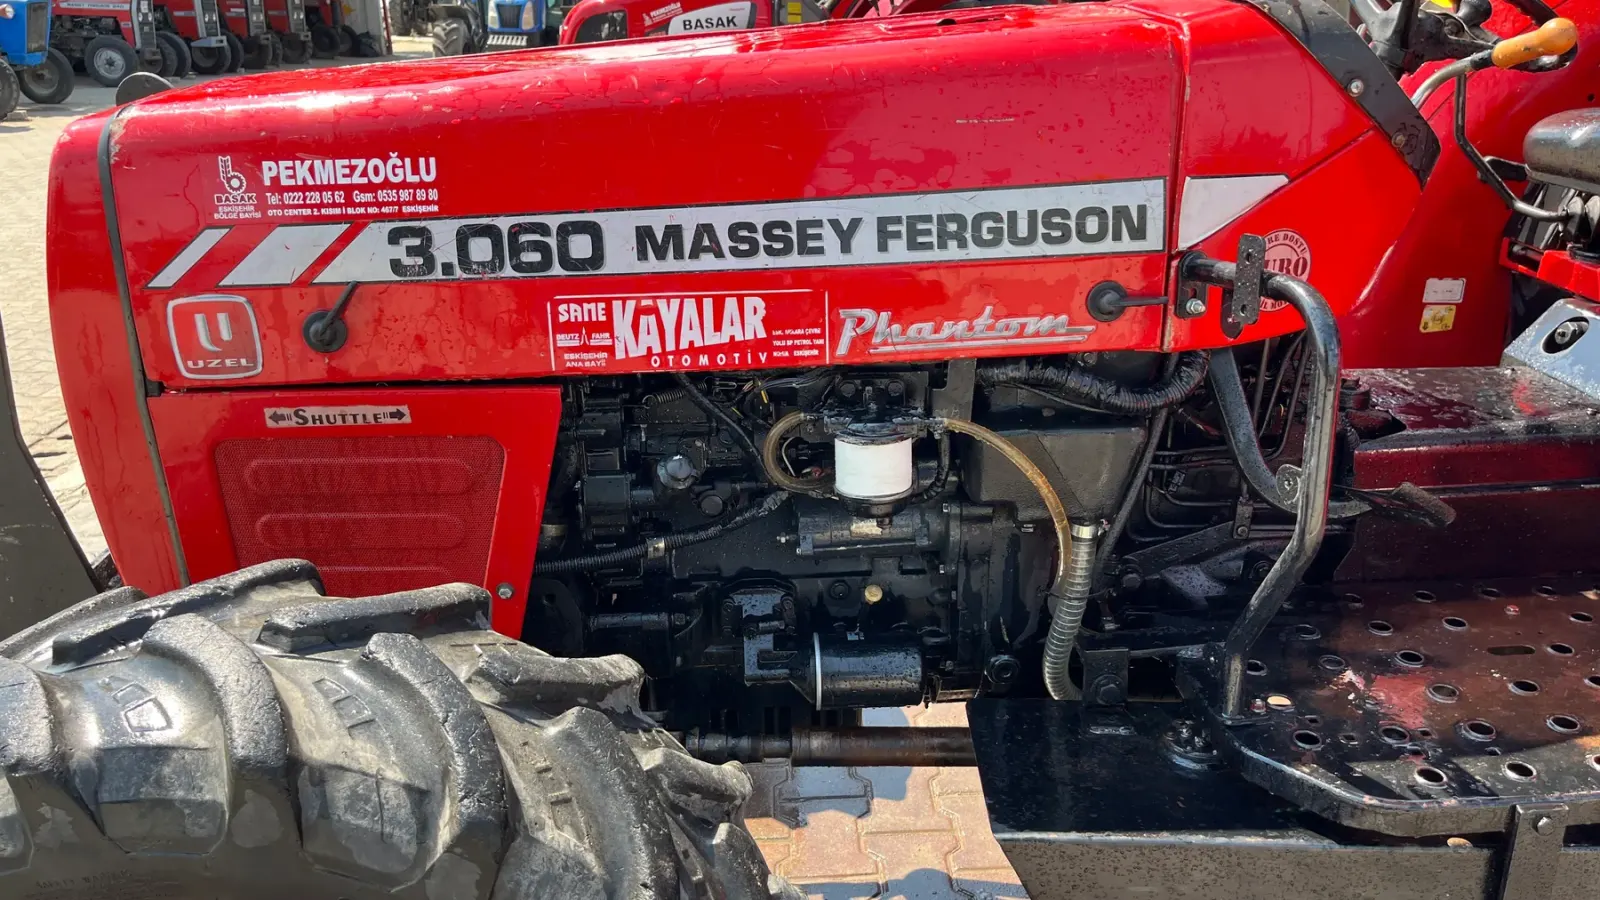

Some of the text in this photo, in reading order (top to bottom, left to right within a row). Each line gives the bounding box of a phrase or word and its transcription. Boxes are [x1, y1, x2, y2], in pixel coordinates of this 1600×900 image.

[682, 16, 737, 30] BASAK
[262, 152, 436, 186] PEKMEZOĞLU
[214, 193, 258, 204] BASAK
[265, 188, 438, 205] Tel: 0222 228 05 62 Gsm: 0535 987 89 80
[267, 209, 283, 217] OTO
[284, 208, 312, 216] CENTER
[347, 206, 366, 214] BLOK
[402, 204, 439, 214] ESKİŞEHİR
[388, 204, 1147, 278] 3.060 MASSEY FERGUSON
[1264, 256, 1308, 277] URO
[612, 296, 768, 360] KAYALAR
[836, 306, 1094, 357] Phantom
[187, 358, 254, 369] UZEL
[651, 350, 767, 367] OTOMOTİV
[295, 408, 382, 426] SHUTTLE
